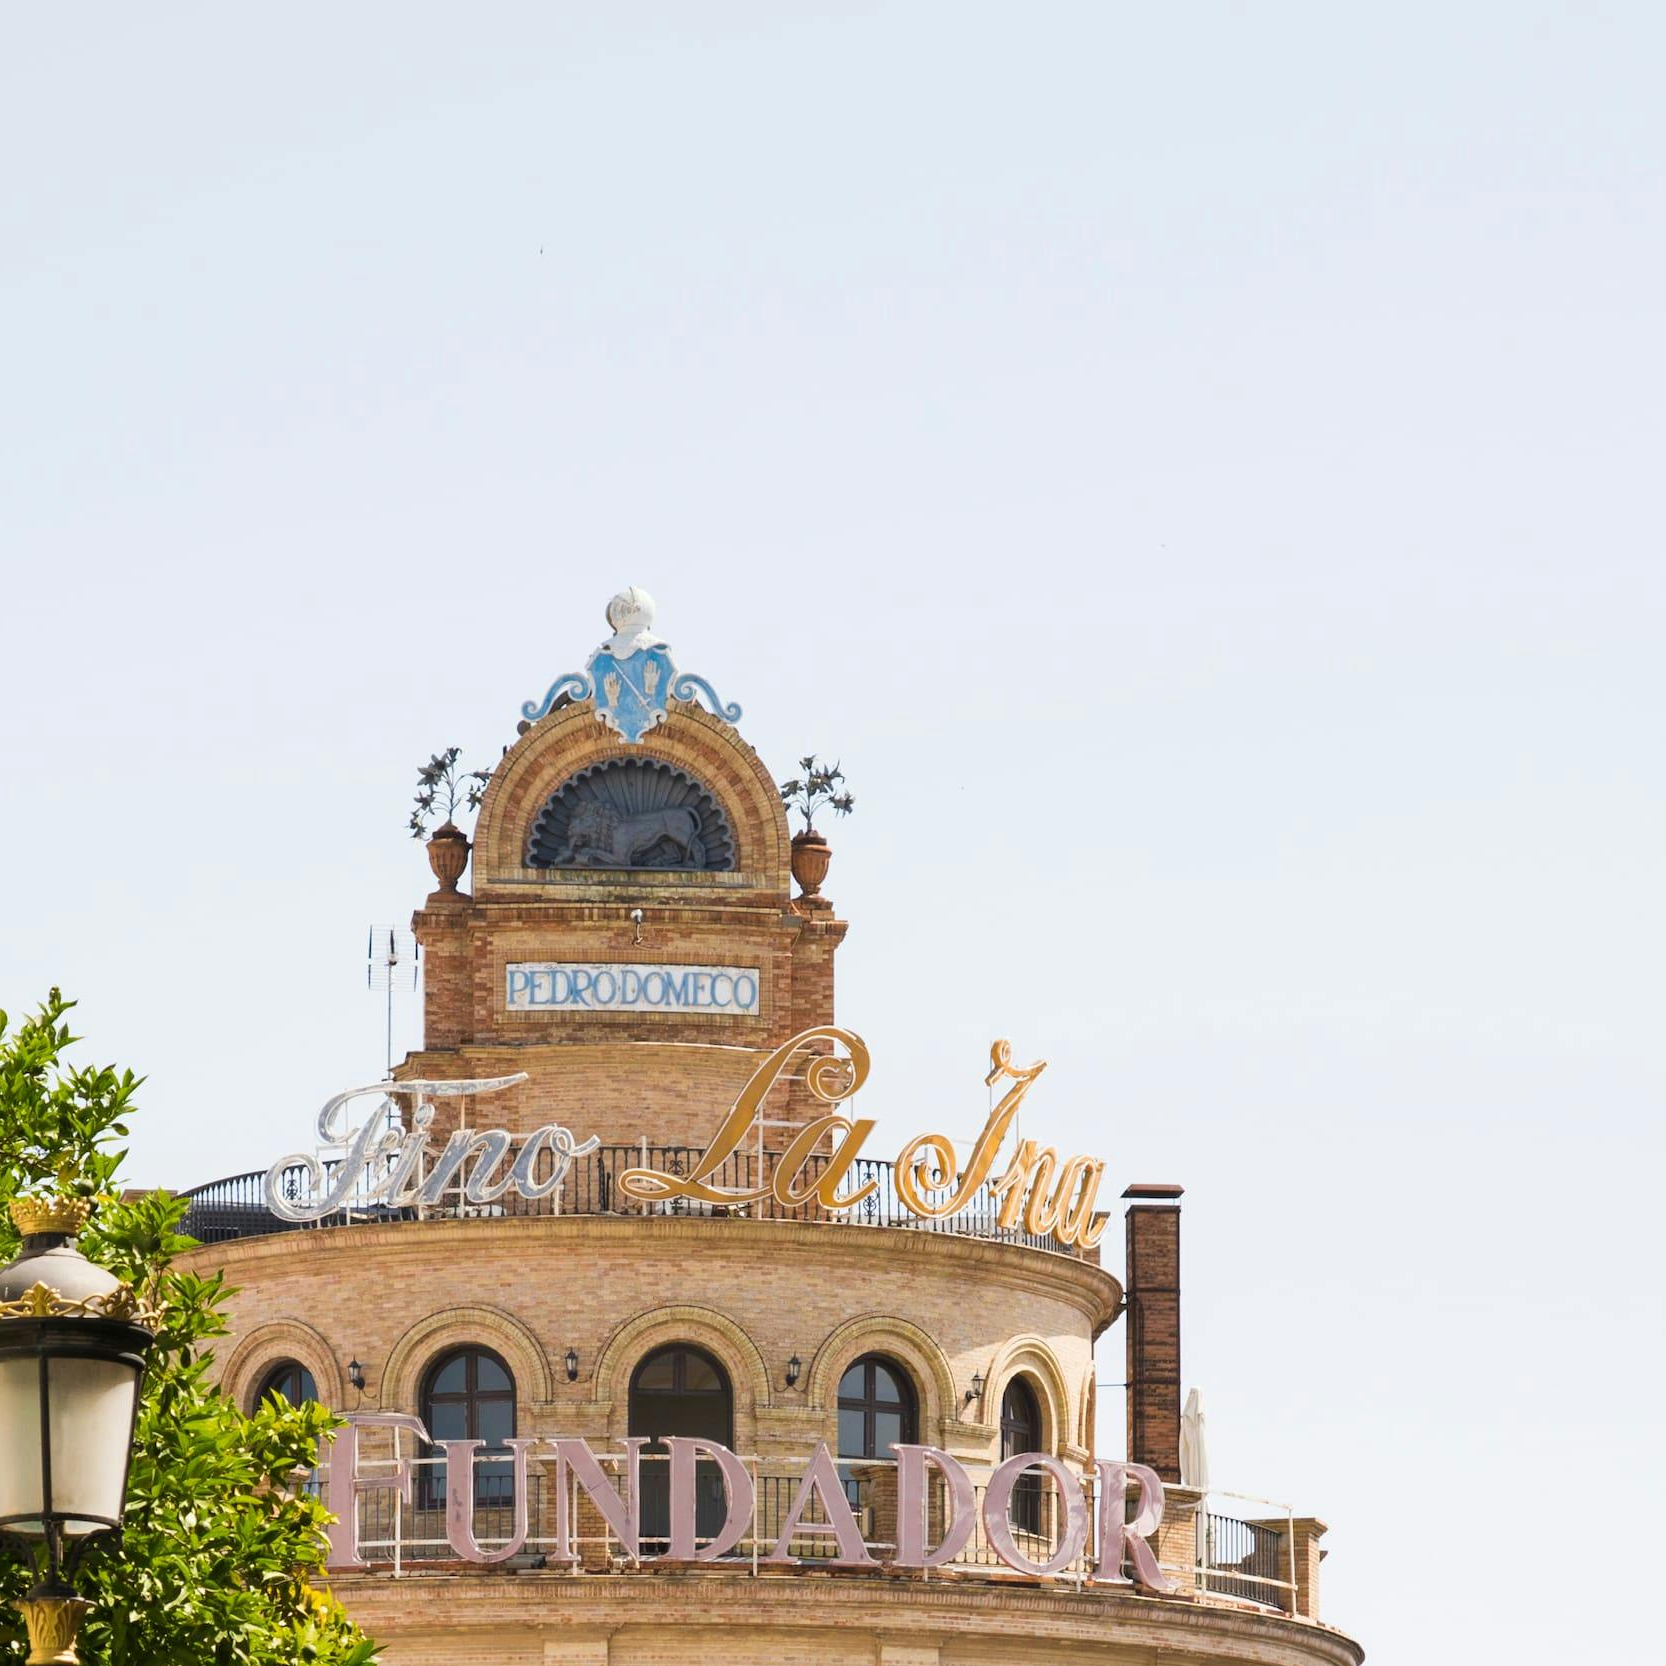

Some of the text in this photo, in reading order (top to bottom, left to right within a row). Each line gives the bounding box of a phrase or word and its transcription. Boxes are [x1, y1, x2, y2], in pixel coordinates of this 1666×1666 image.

[508, 969, 617, 1007] PEDRO
[265, 1025, 1110, 1250] Fino La Ina
[325, 1413, 1182, 1591] FUNDADOR
